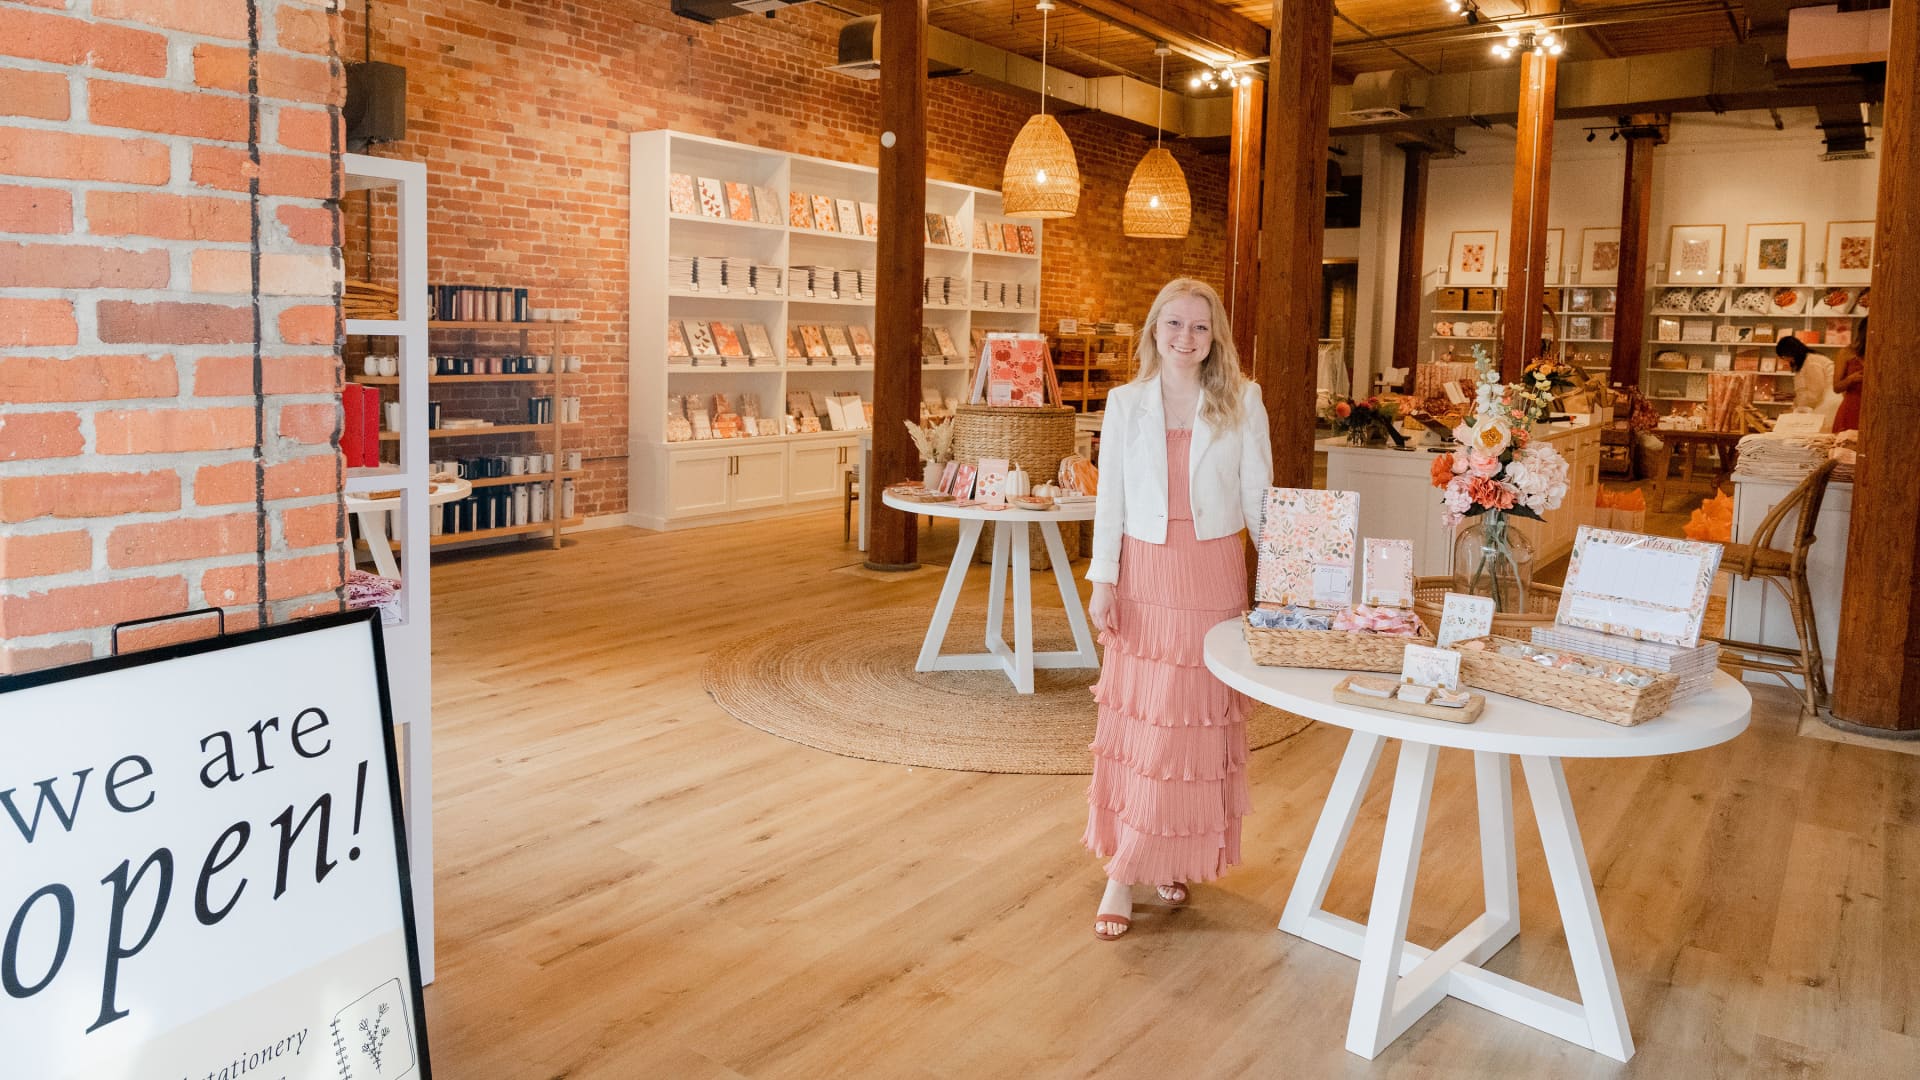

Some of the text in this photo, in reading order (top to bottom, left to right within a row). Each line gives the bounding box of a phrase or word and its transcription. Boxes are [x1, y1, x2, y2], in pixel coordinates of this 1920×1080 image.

[0, 706, 332, 844] we are
[0, 760, 369, 1036] open!
[201, 1027, 308, 1080] ationery
